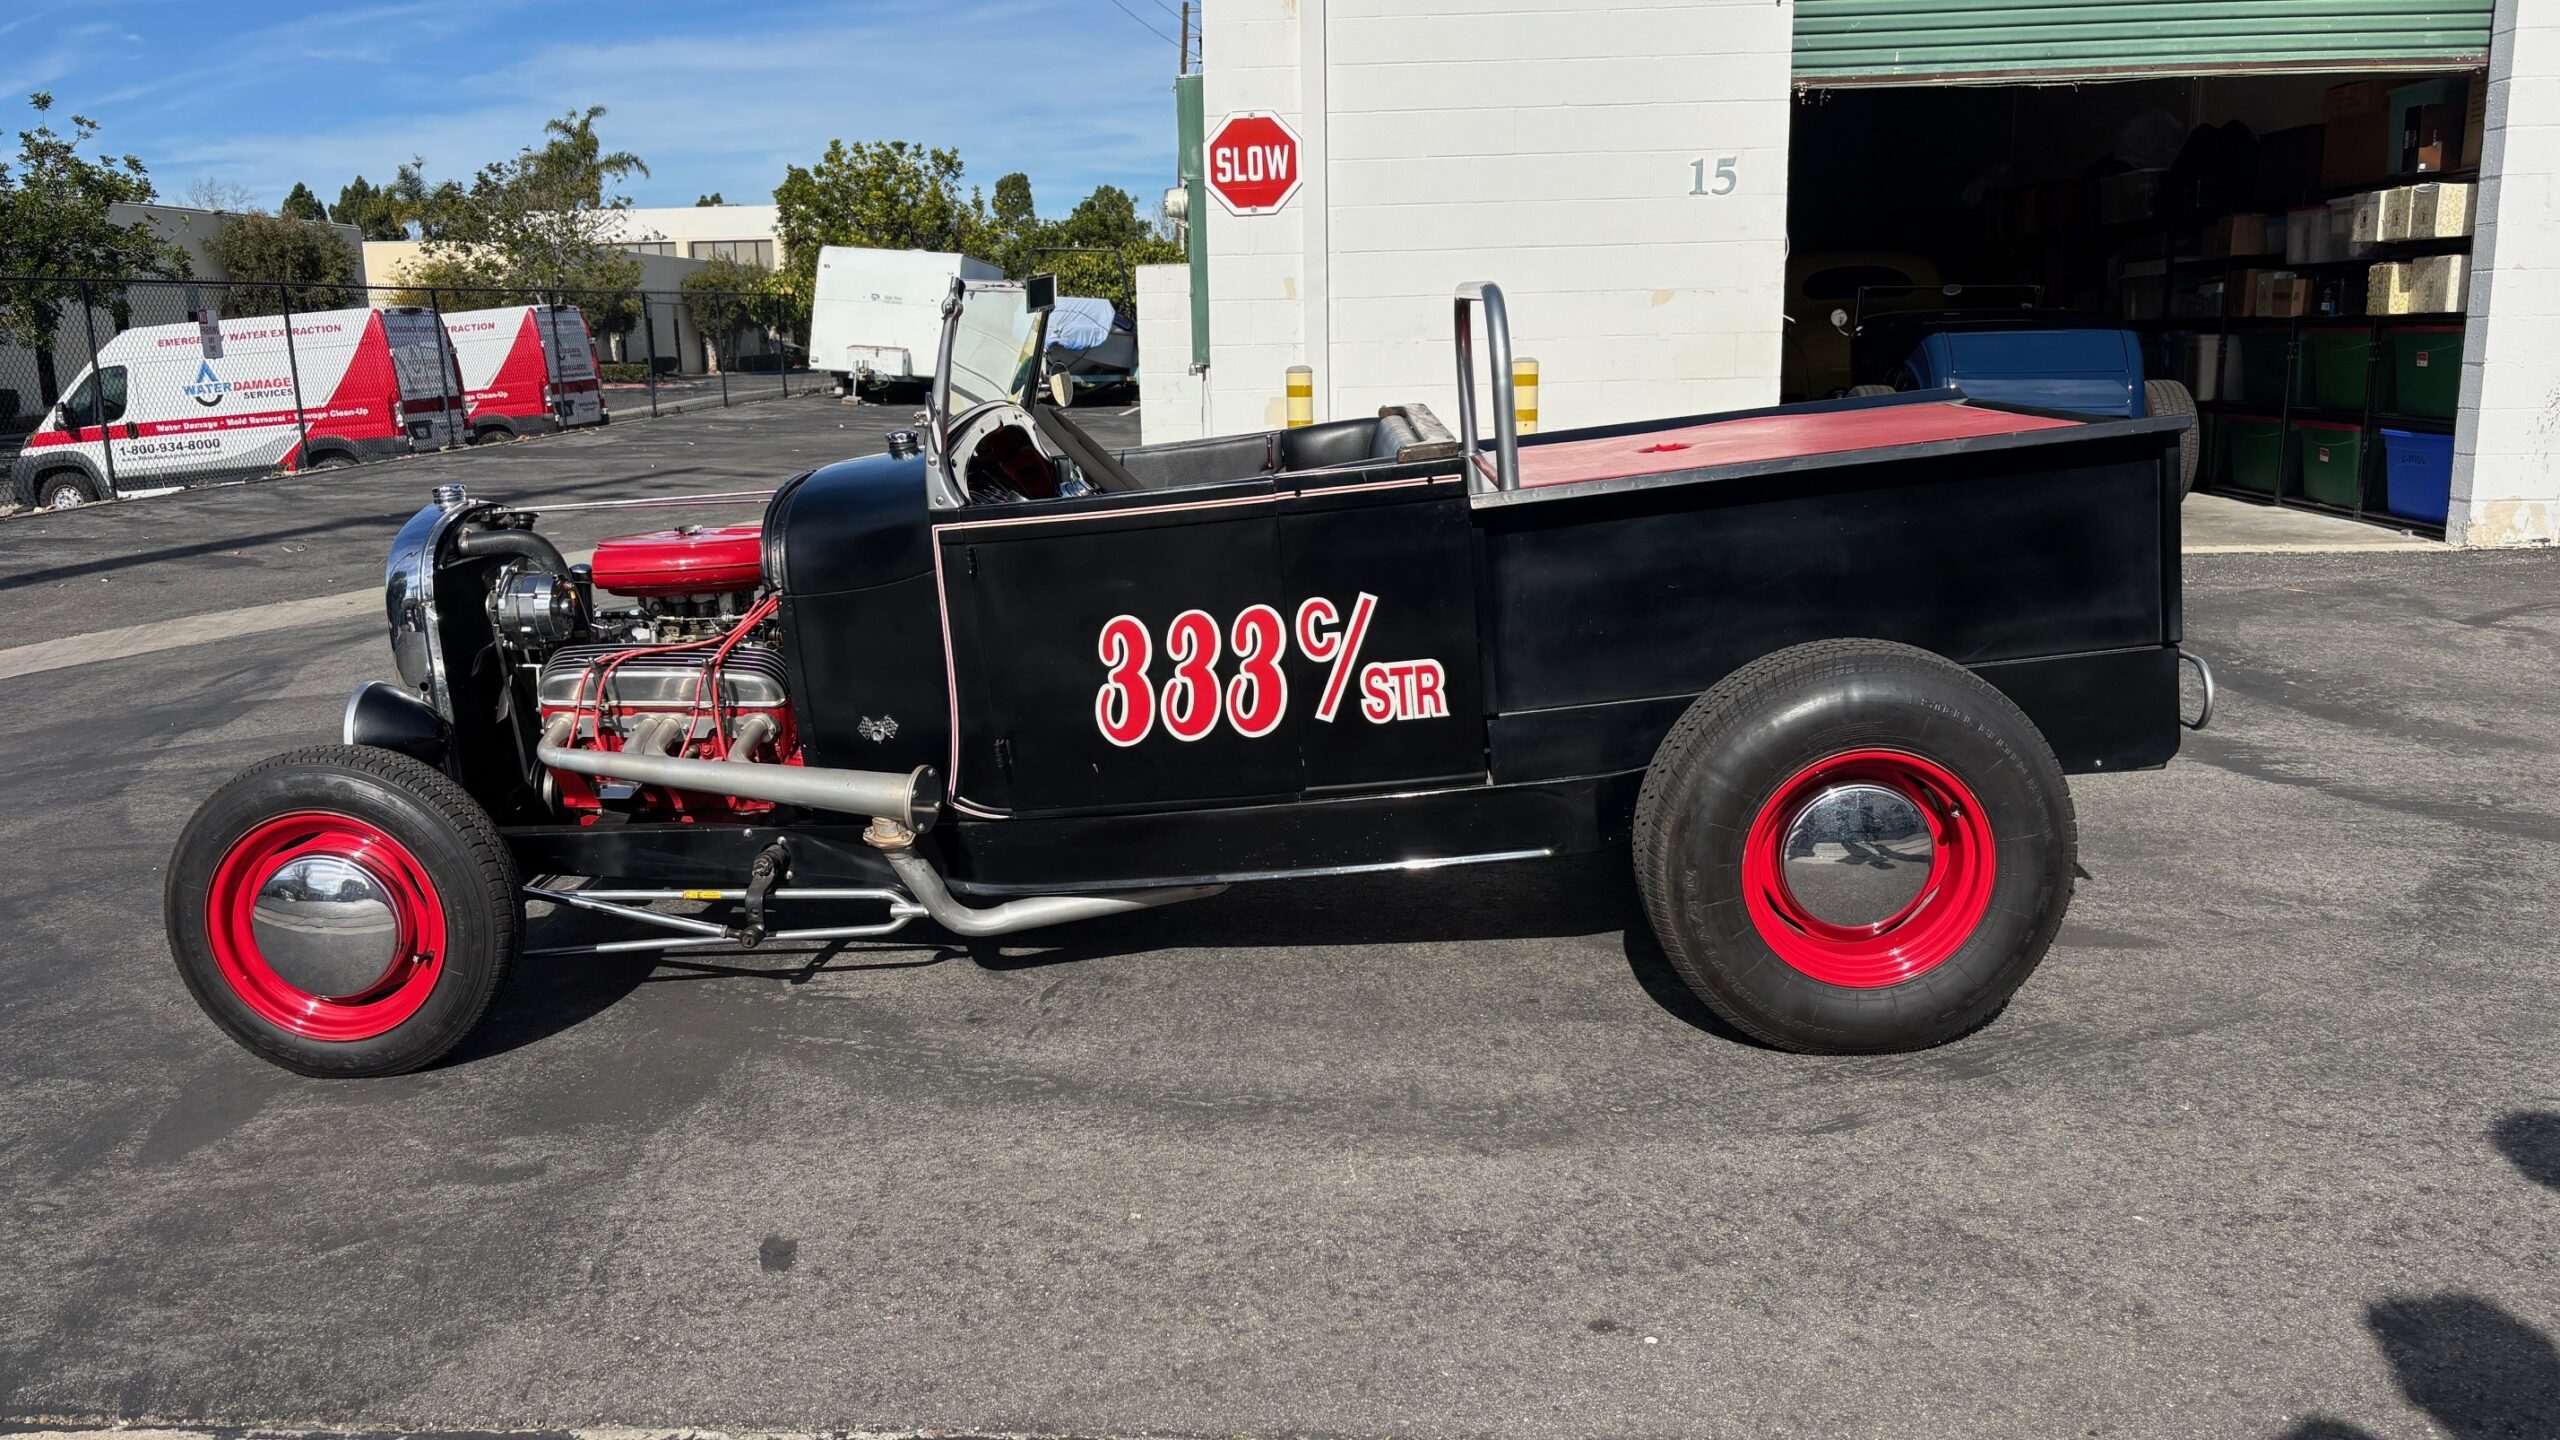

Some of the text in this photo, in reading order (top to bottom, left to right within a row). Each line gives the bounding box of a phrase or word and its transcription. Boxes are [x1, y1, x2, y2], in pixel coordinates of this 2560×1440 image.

[1216, 144, 1289, 183] SLOW
[1688, 155, 1737, 196] 15
[157, 332, 225, 348] EMERGEY
[229, 329, 267, 341] WATER
[271, 323, 342, 338] EXRACTION
[244, 388, 294, 399] SERVICES
[156, 407, 369, 433] Water Damage Mold Removal Swage Clean-Up
[120, 438, 221, 457] 1-800-934-8000
[1095, 604, 1288, 748] 333
